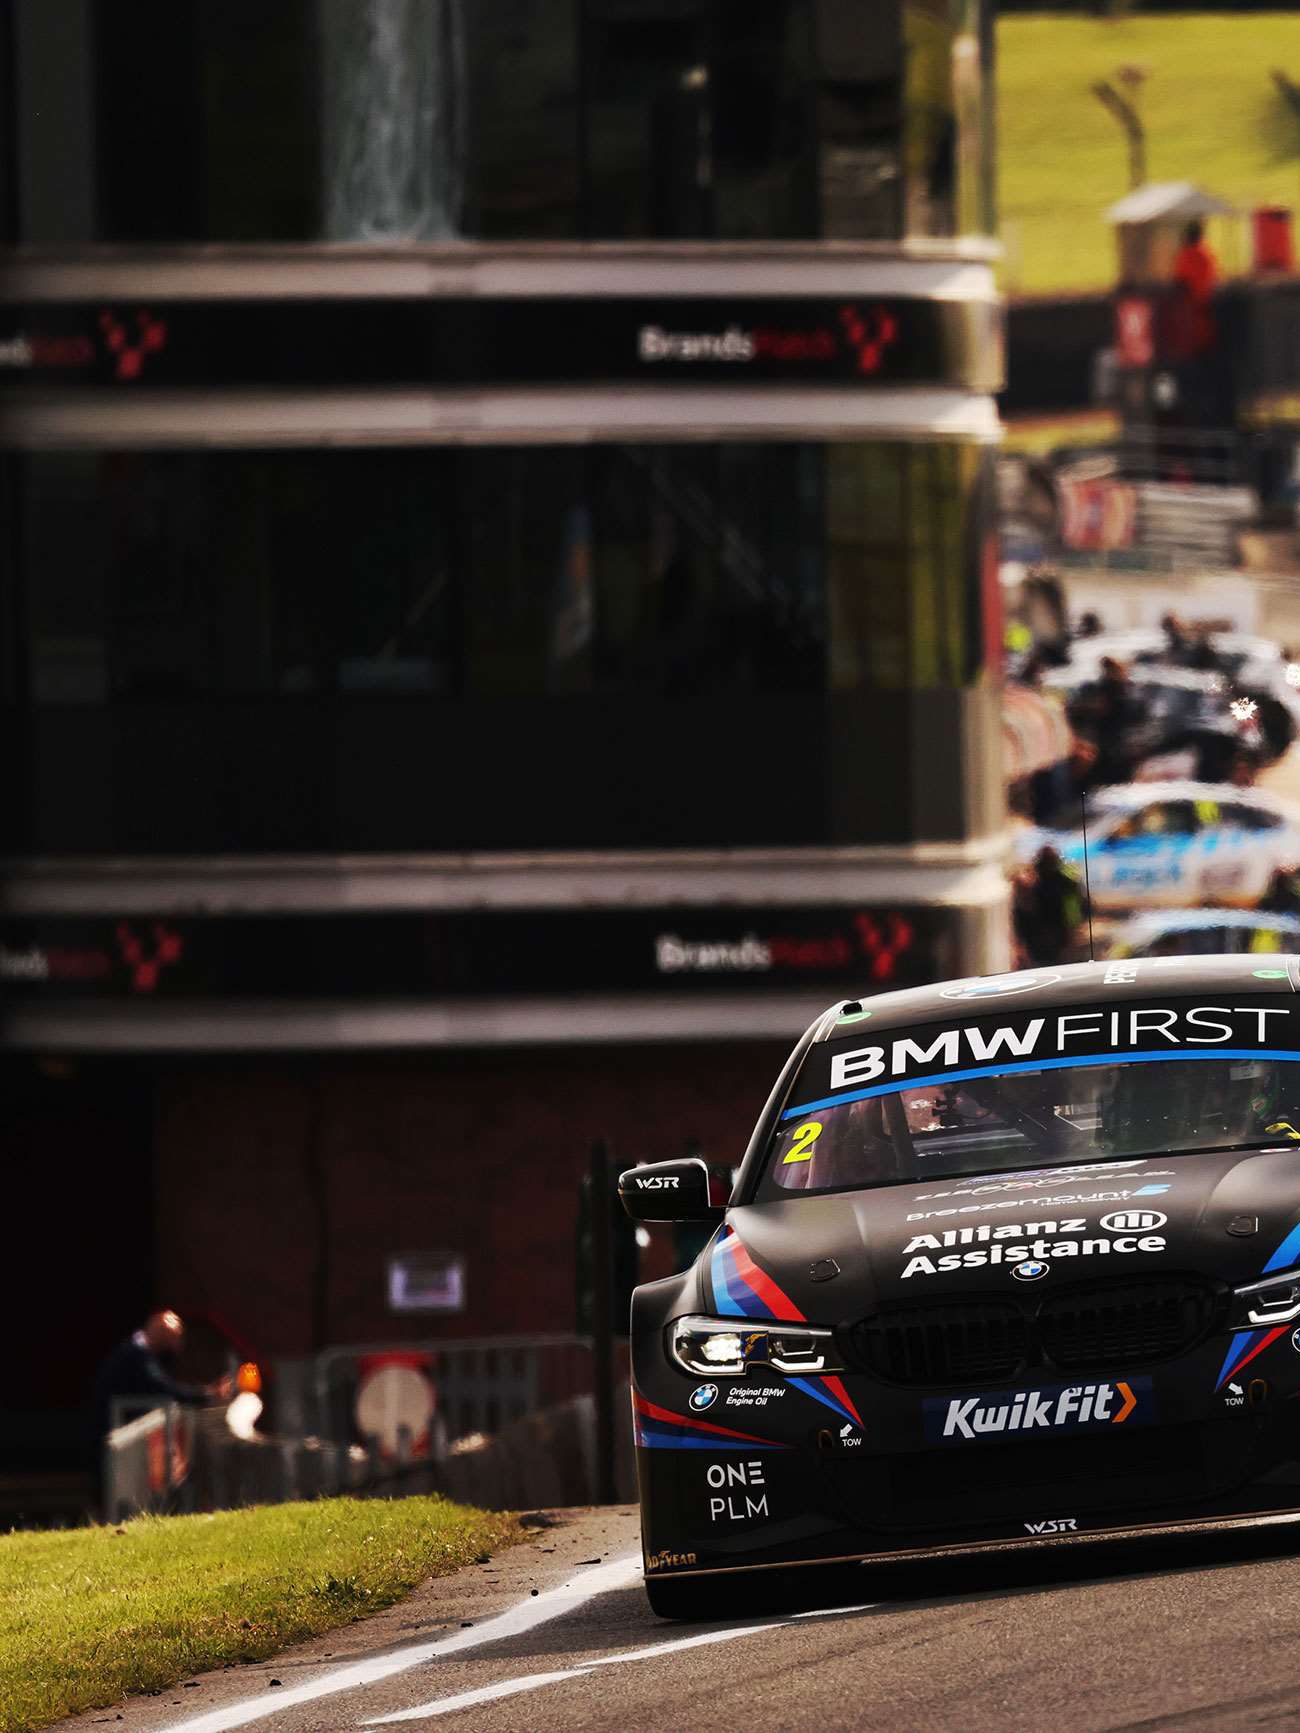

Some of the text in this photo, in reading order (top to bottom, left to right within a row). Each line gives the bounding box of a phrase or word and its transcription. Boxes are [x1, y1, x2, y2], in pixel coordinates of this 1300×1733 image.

[830, 1006, 1291, 1091] BMW FIRST
[782, 1121, 823, 1164] 2
[635, 1176, 680, 1190] WSR
[902, 1218, 1087, 1254] Allianz
[900, 1235, 1167, 1279] Assistance
[726, 1396, 768, 1407] Engine Oil
[729, 1387, 761, 1398] Original
[762, 1387, 786, 1397] BMW
[1224, 1397, 1245, 1406] TOW
[841, 1438, 862, 1447] TOW
[706, 1461, 765, 1489] ONE
[710, 1493, 770, 1522] PLM
[1024, 1518, 1079, 1535] WSR
